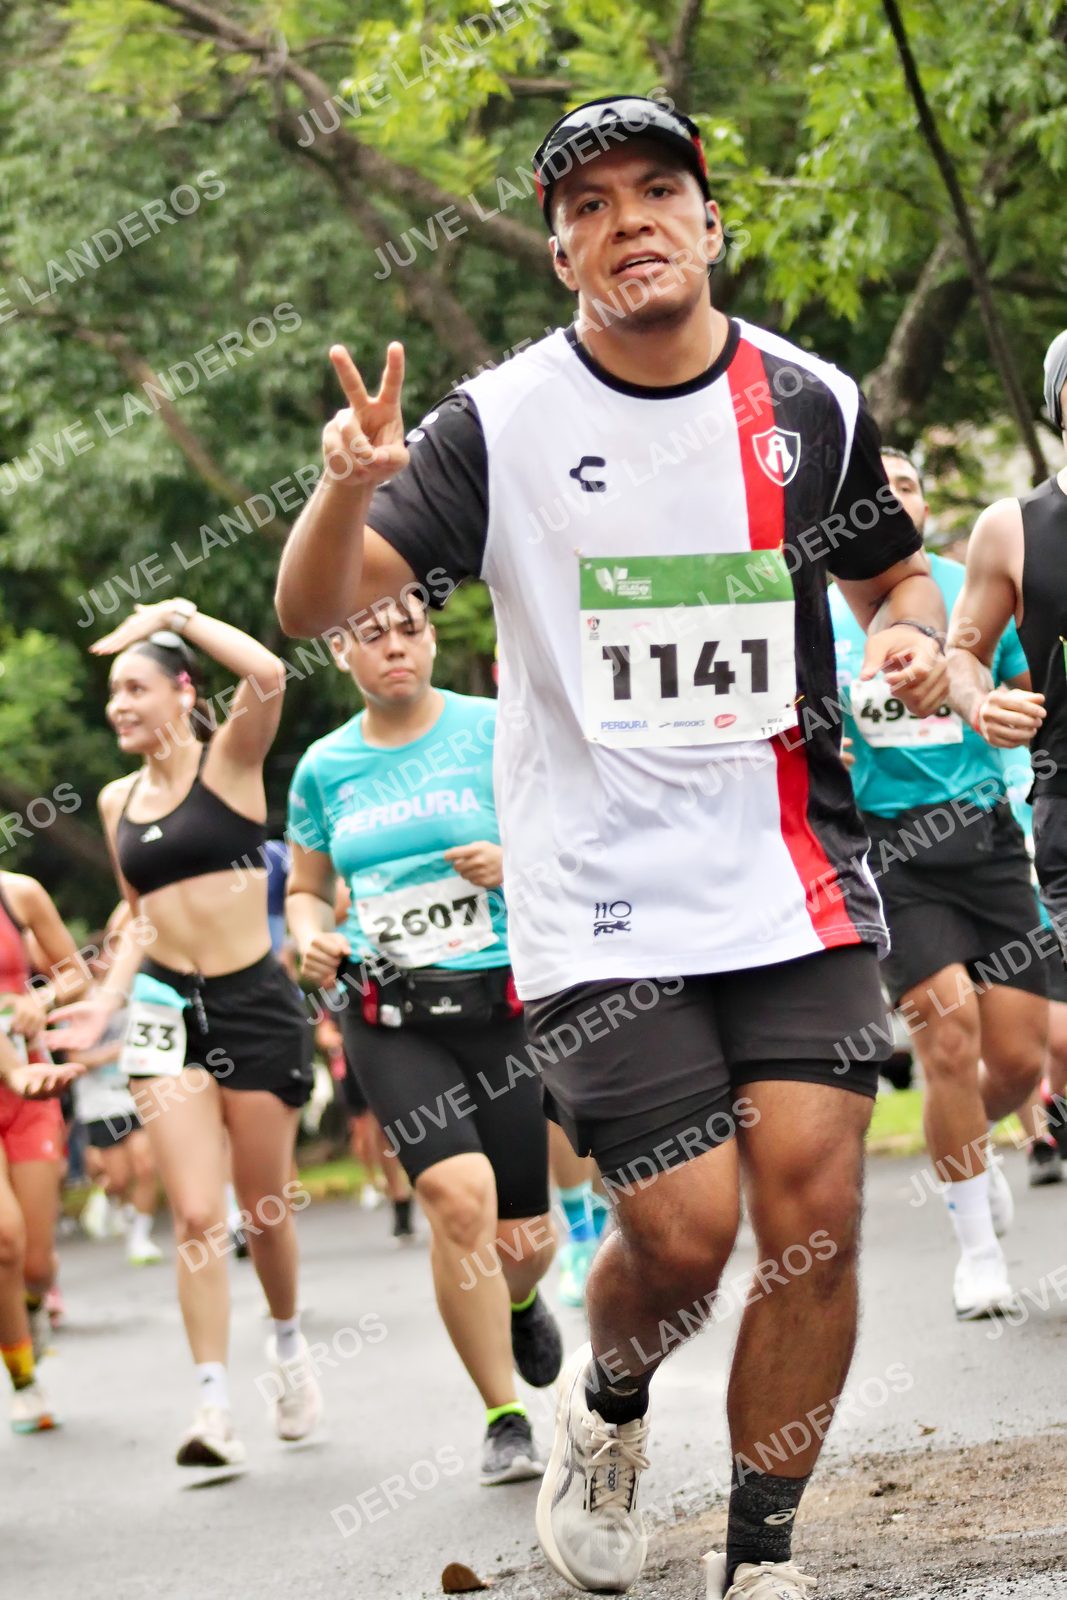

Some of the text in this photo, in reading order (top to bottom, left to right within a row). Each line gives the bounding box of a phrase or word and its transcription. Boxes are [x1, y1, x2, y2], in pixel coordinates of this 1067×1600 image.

[602, 638, 769, 701] 1141
[673, 719, 706, 728] BROOKS
[861, 698, 951, 723] 49
[600, 720, 648, 731] PERDURA
[334, 786, 480, 840] PERDURA
[373, 895, 479, 944] 2607
[127, 1022, 177, 1051] 33
